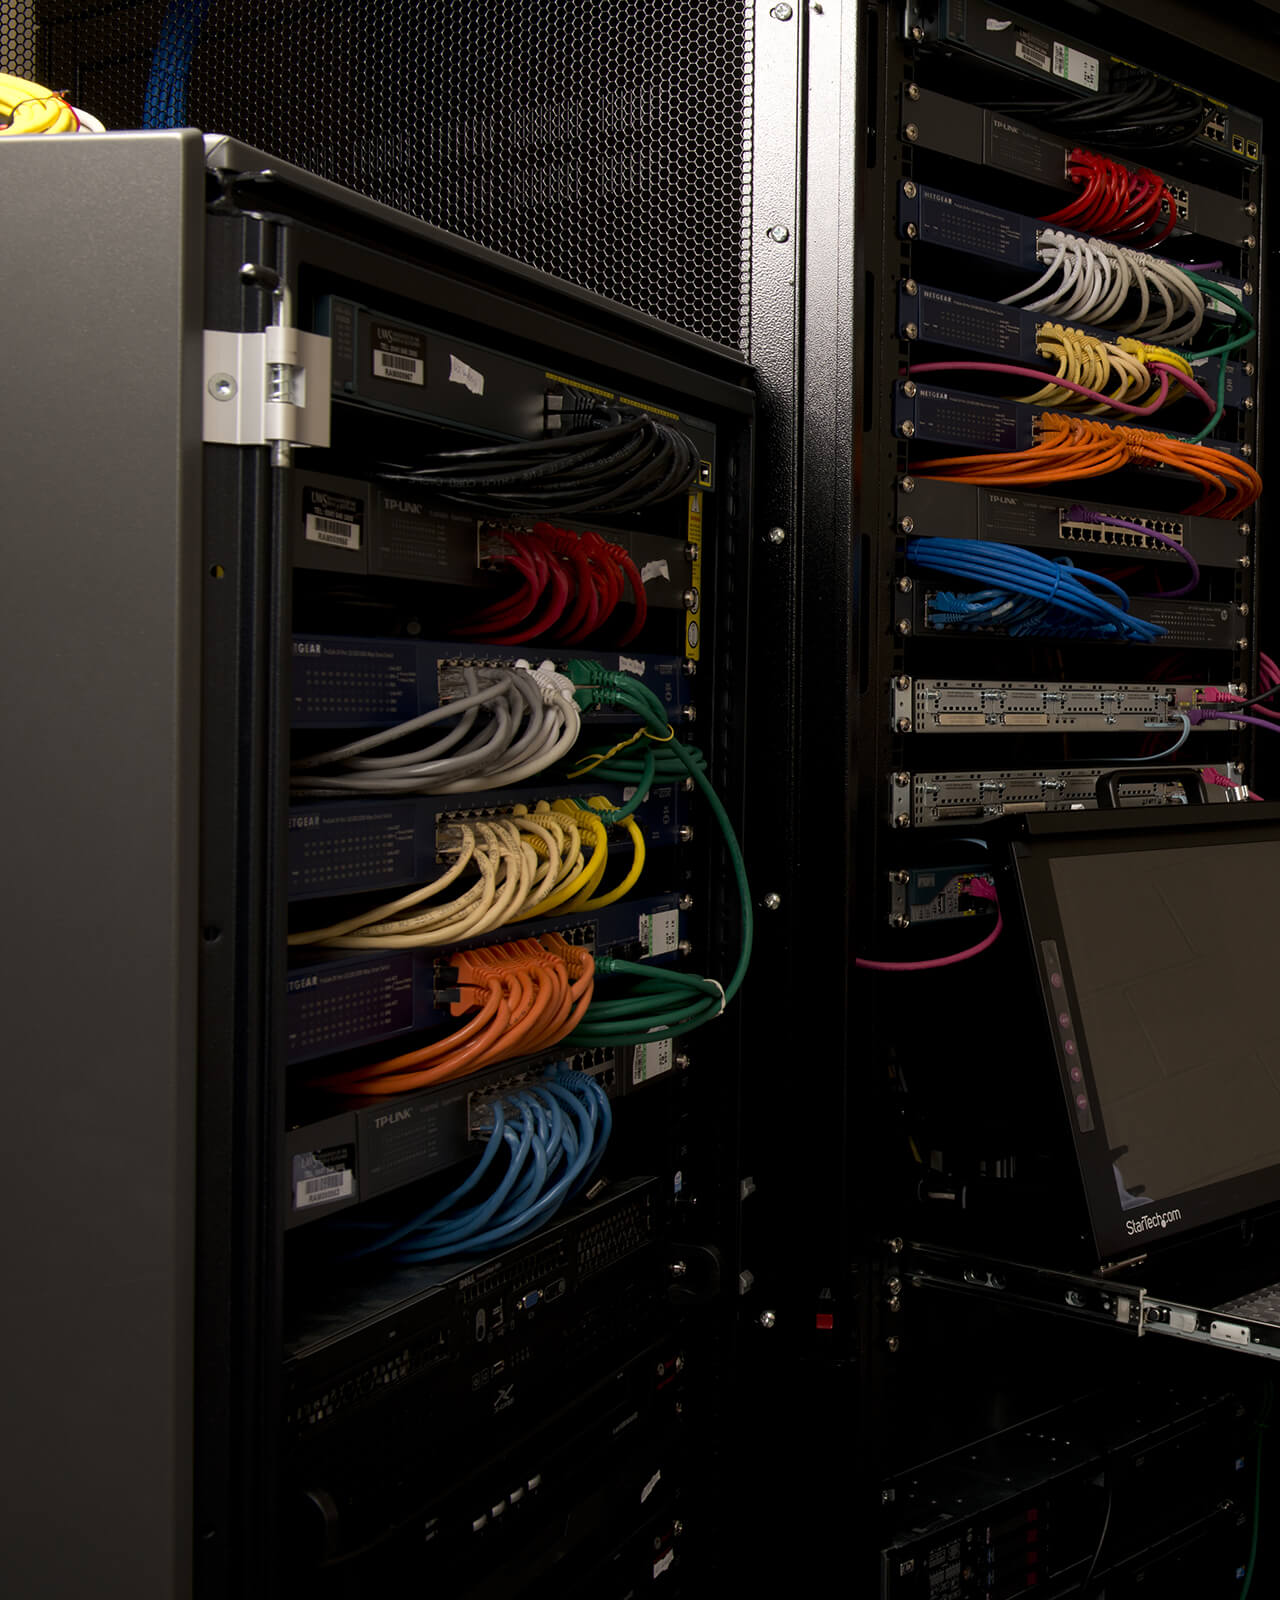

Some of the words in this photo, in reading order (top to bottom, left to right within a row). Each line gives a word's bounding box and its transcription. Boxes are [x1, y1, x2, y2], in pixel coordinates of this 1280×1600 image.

[924, 191, 952, 204] NETGEAR
[923, 290, 952, 303] NETGEAR
[920, 389, 948, 400] NETGEAR
[383, 497, 424, 514] TP-LINK
[989, 494, 1017, 505] TP-LINK
[293, 642, 321, 655] TGEAR
[288, 816, 320, 829] TGEAR
[287, 975, 318, 991] TGEAR
[375, 1108, 413, 1128] TP-LINK
